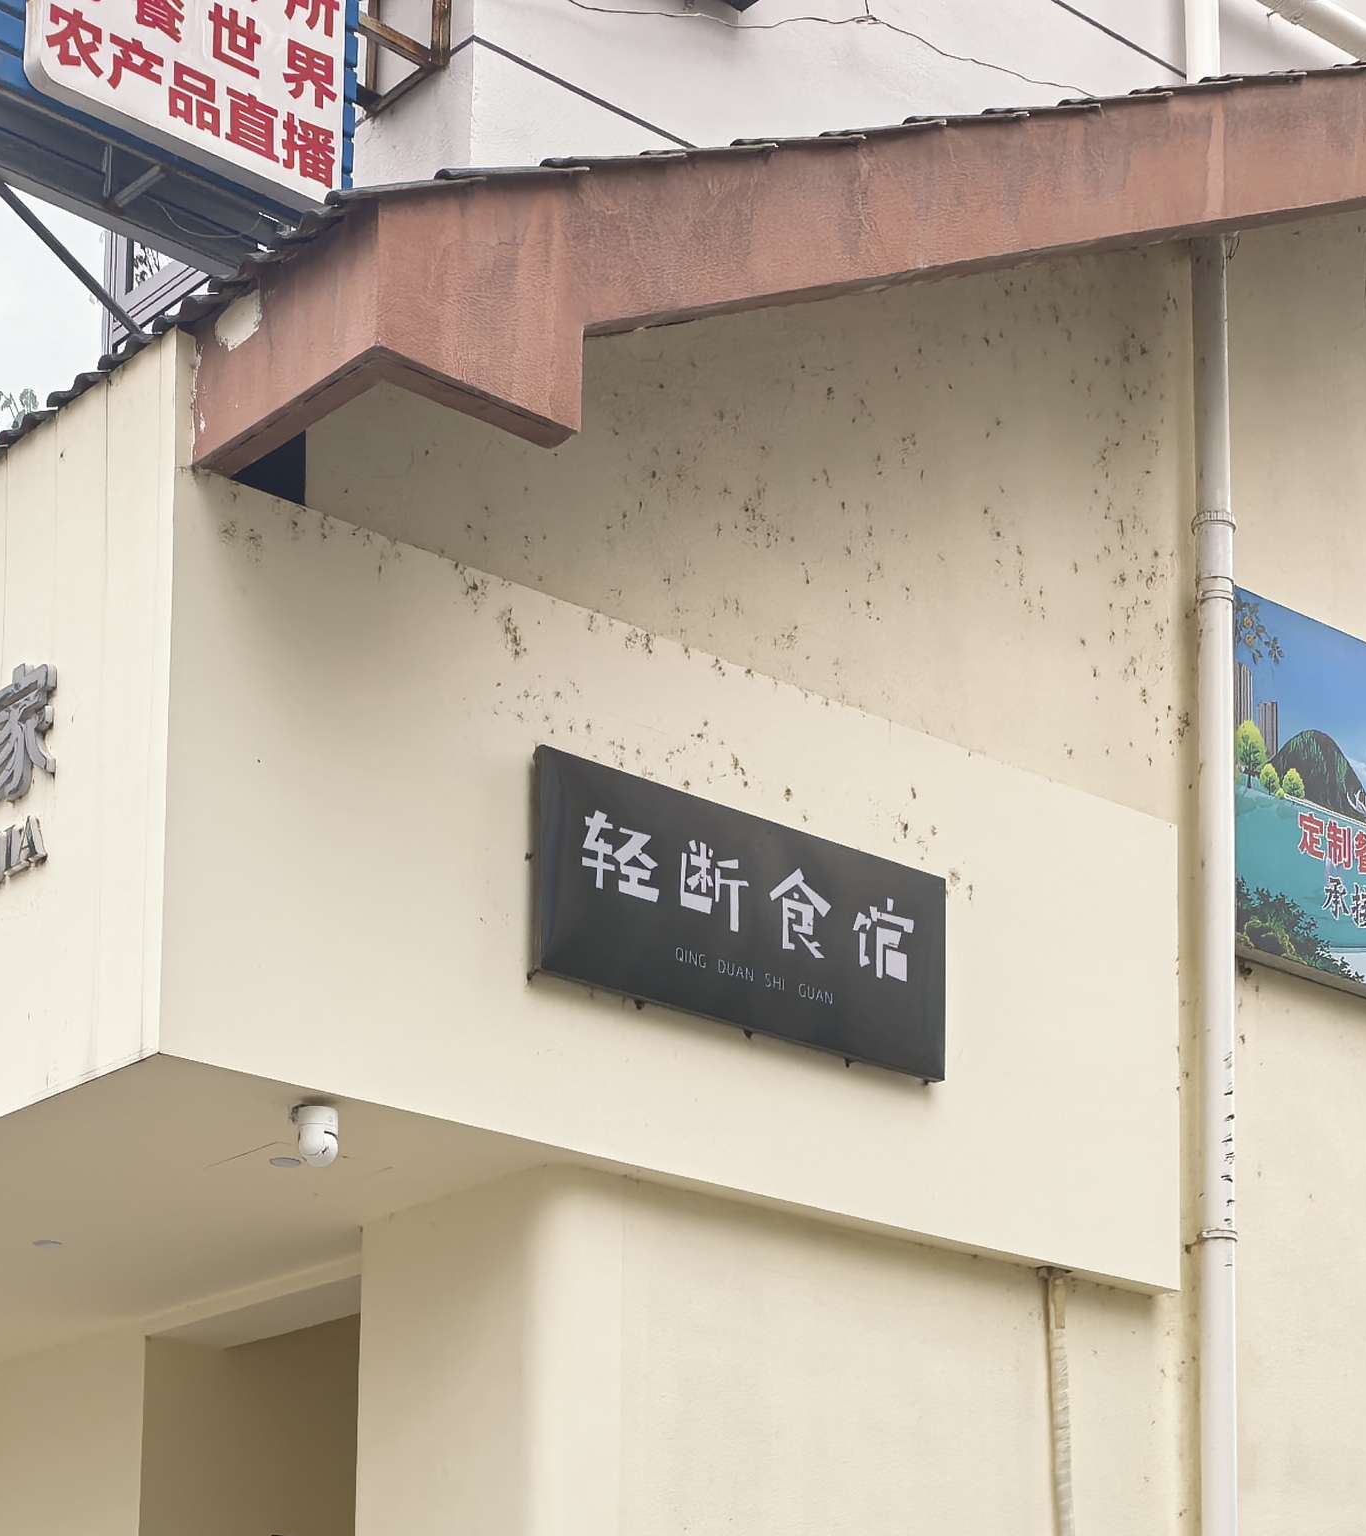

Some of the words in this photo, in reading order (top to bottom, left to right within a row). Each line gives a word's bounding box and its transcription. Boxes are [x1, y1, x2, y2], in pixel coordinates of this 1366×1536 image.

[44, 7, 338, 190] 农产品直播
[581, 809, 915, 983] 轻断食馆
[674, 945, 707, 970] QING
[716, 958, 756, 983] DUAN
[764, 971, 787, 991] SHI
[797, 981, 834, 1005] GUAN
